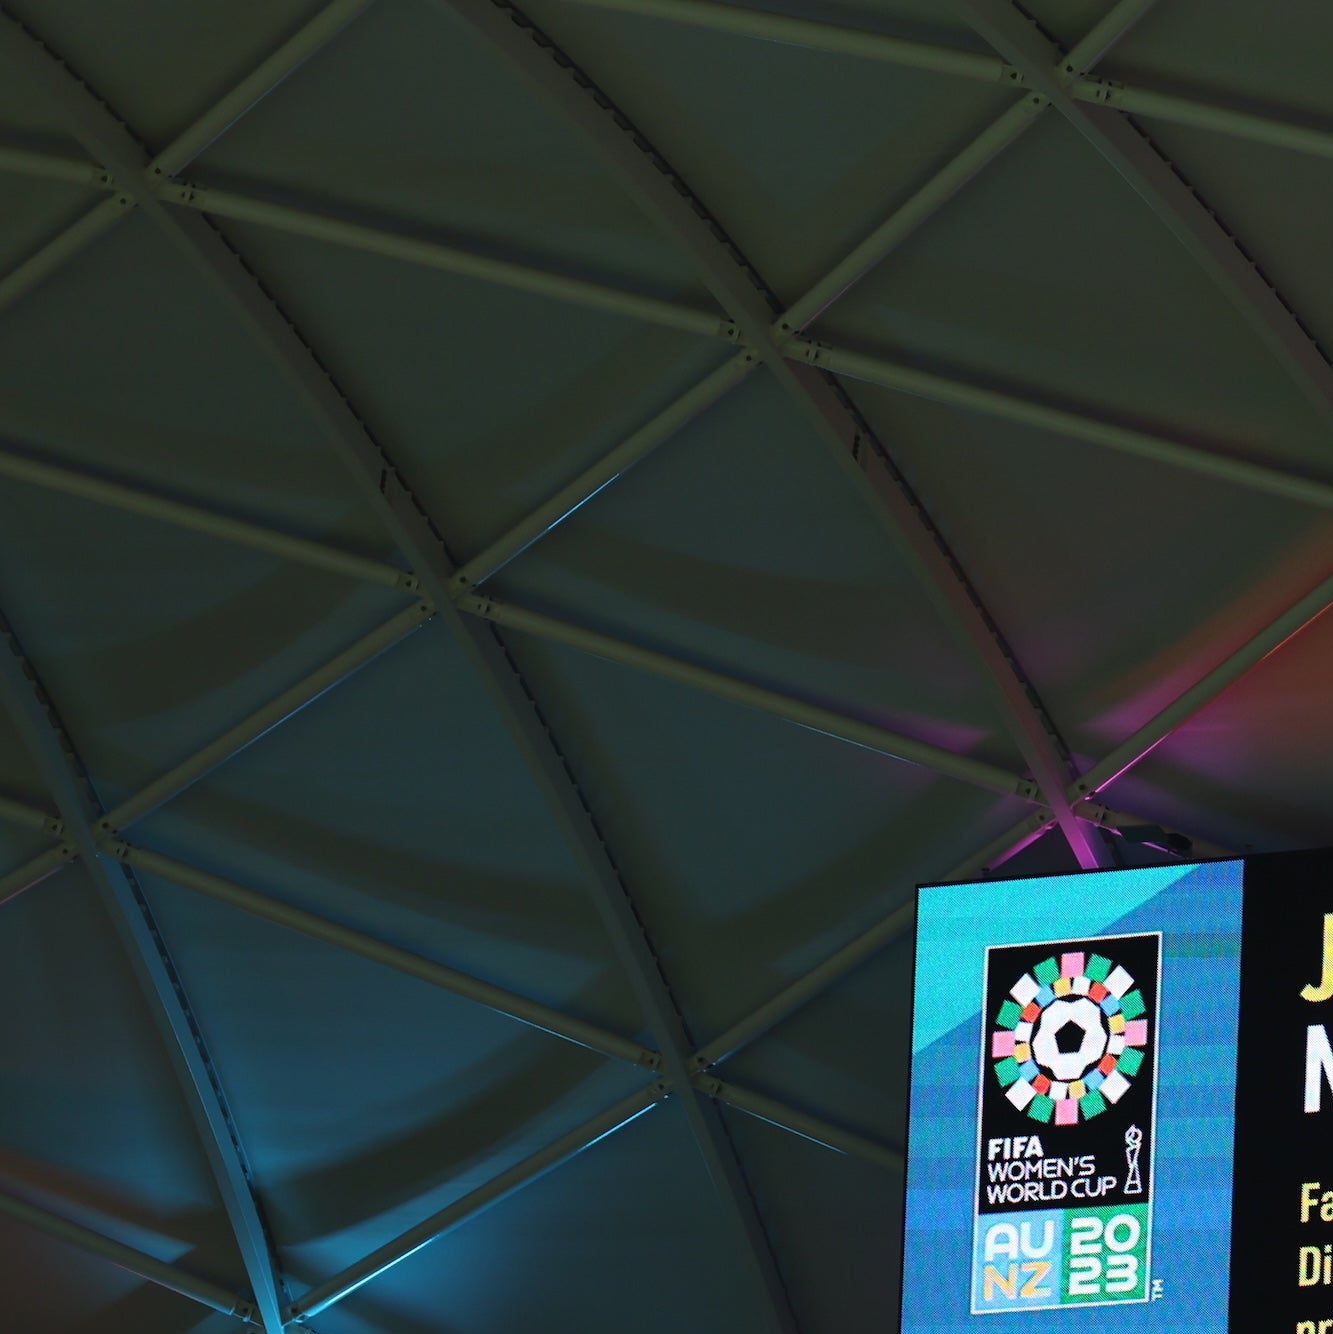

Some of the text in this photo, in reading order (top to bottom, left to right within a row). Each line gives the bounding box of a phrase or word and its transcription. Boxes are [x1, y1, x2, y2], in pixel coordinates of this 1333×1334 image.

[987, 1135, 1044, 1161] FIFA
[987, 1155, 1096, 1183] WOMEN'S
[986, 1176, 1118, 1204] WORLD CUP
[984, 1220, 1054, 1262] AU
[983, 1261, 1052, 1302] NZ
